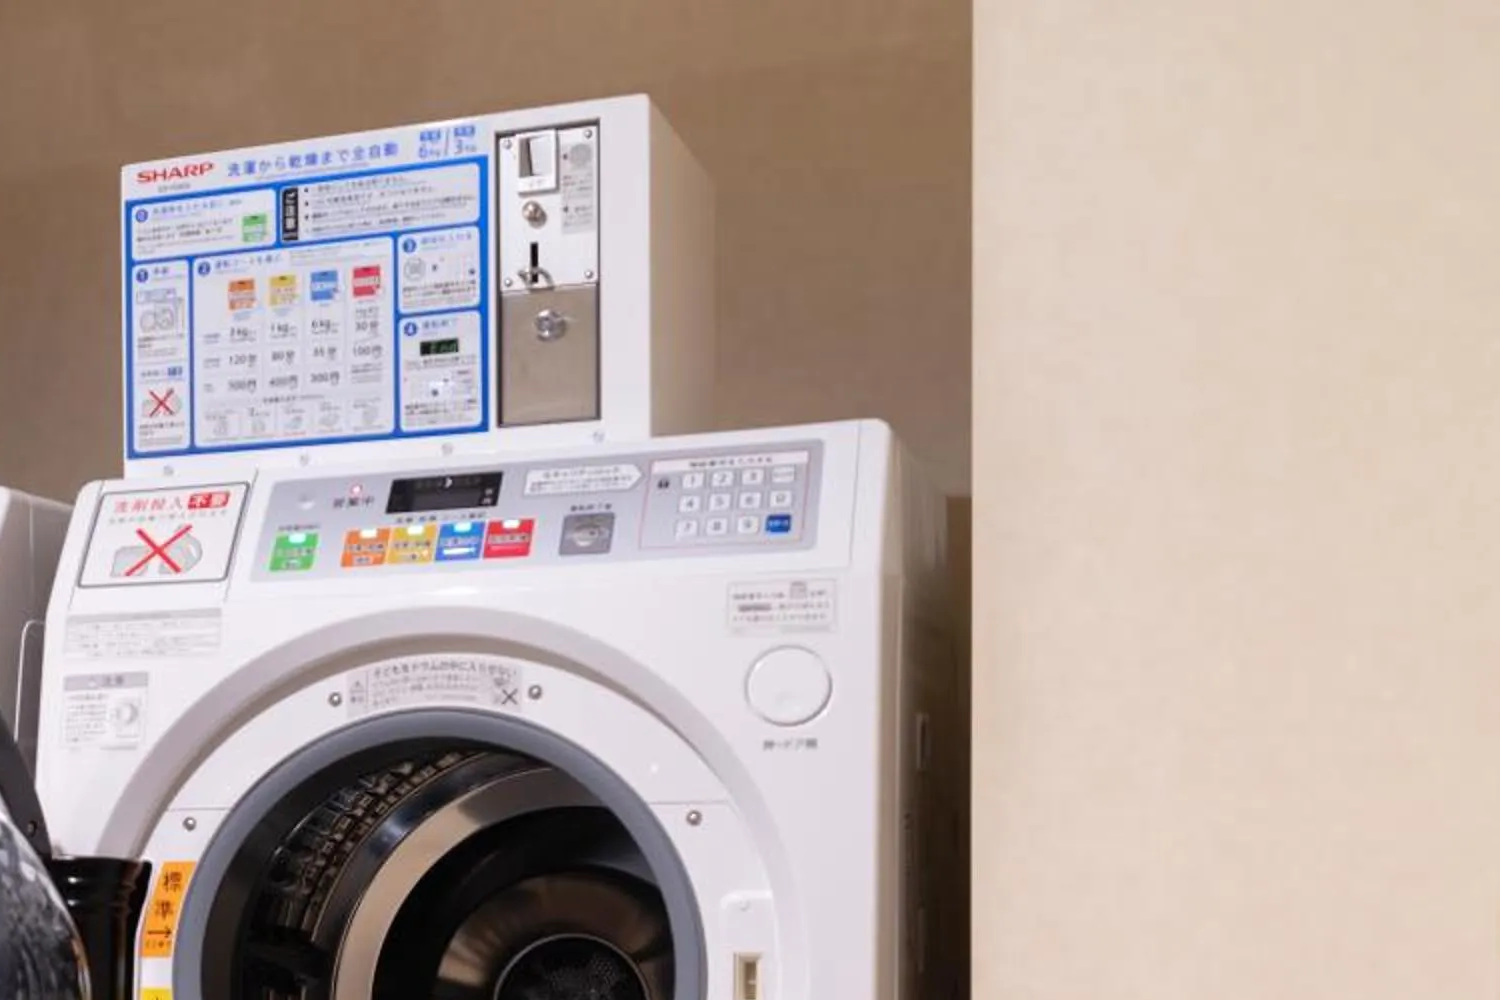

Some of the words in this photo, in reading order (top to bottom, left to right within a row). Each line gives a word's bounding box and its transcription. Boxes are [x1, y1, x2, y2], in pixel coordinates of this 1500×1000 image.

[136, 161, 214, 183] SHARP
[227, 142, 398, 177] 洗濯から乾燥まで全自動
[155, 871, 182, 919] 標準
